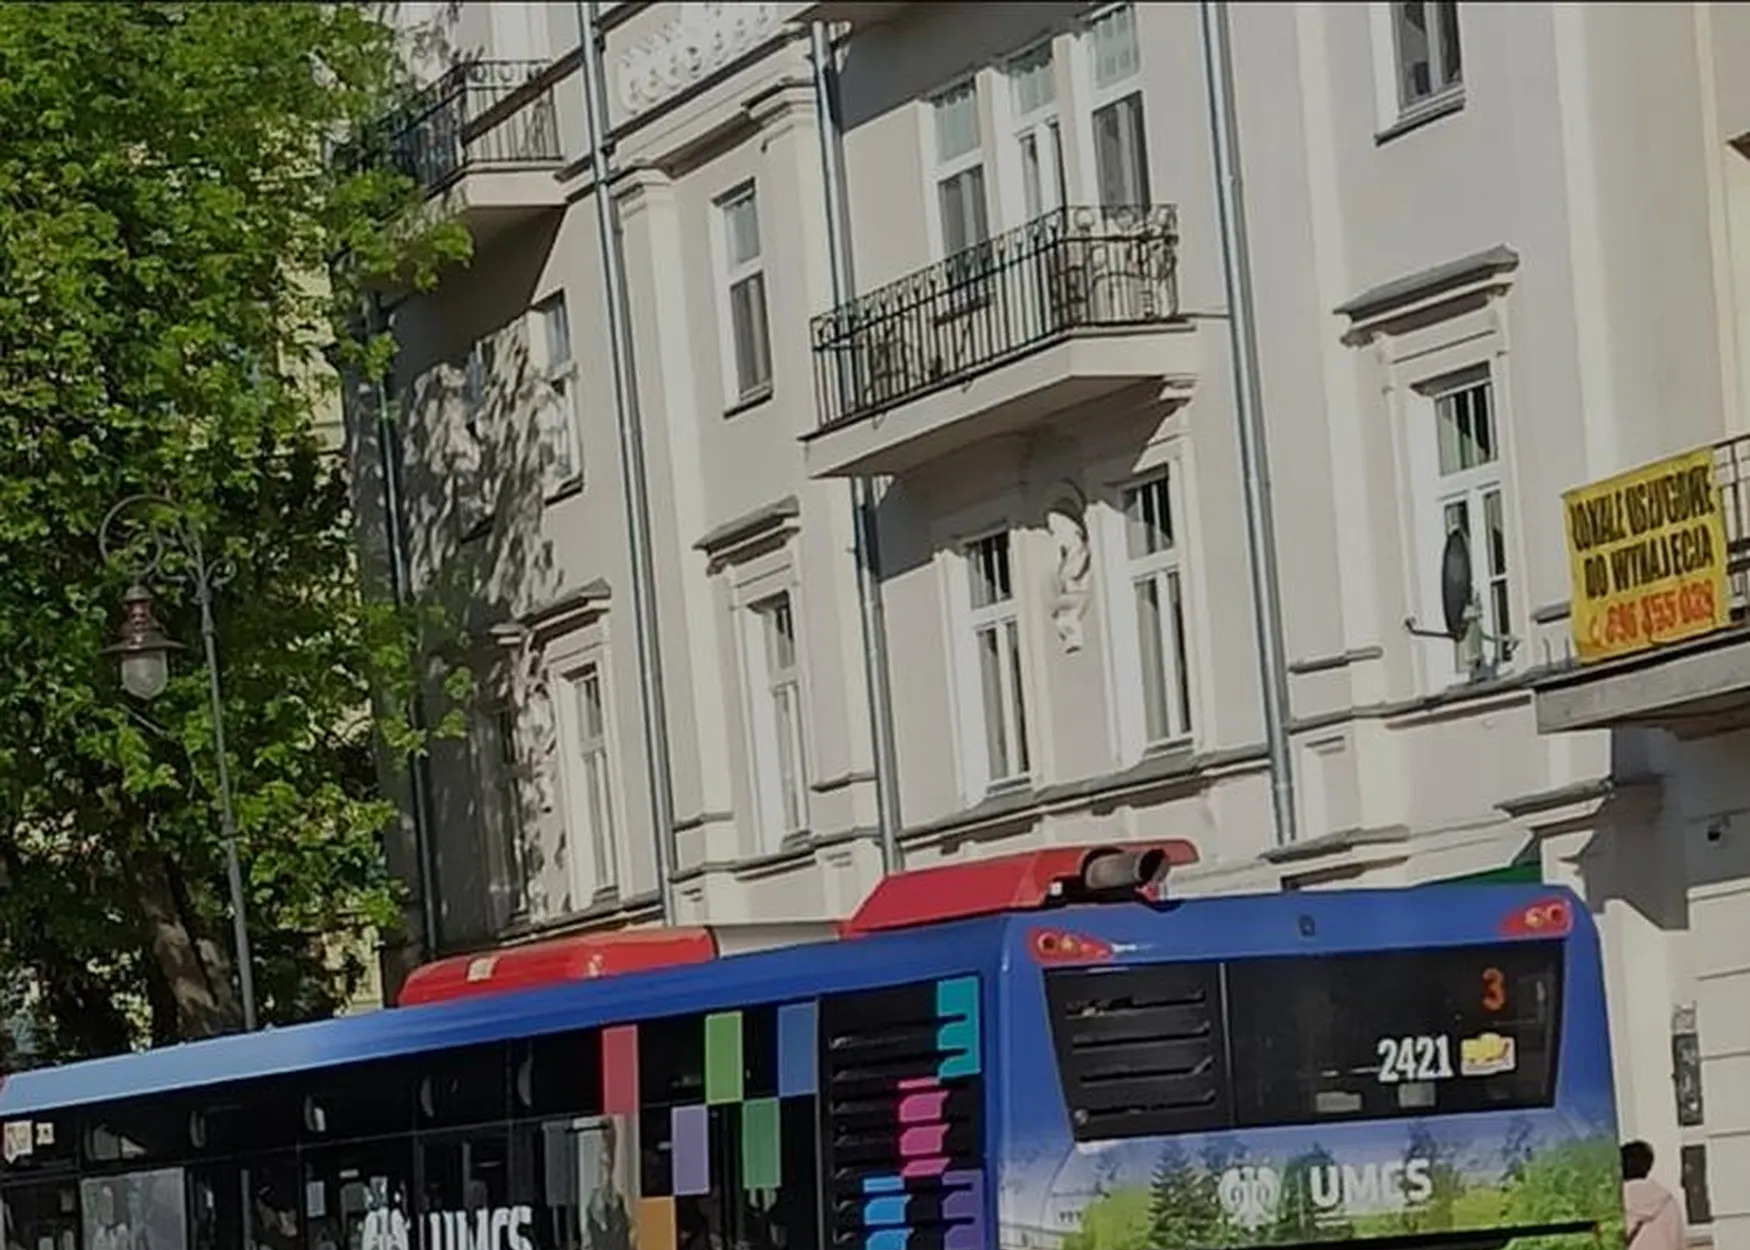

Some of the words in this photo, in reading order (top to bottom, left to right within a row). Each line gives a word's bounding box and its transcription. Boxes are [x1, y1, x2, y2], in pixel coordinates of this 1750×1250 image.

[1481, 966, 1506, 1011] 3
[1376, 1033, 1455, 1083] 2421
[1310, 1158, 1434, 1208] UMCS
